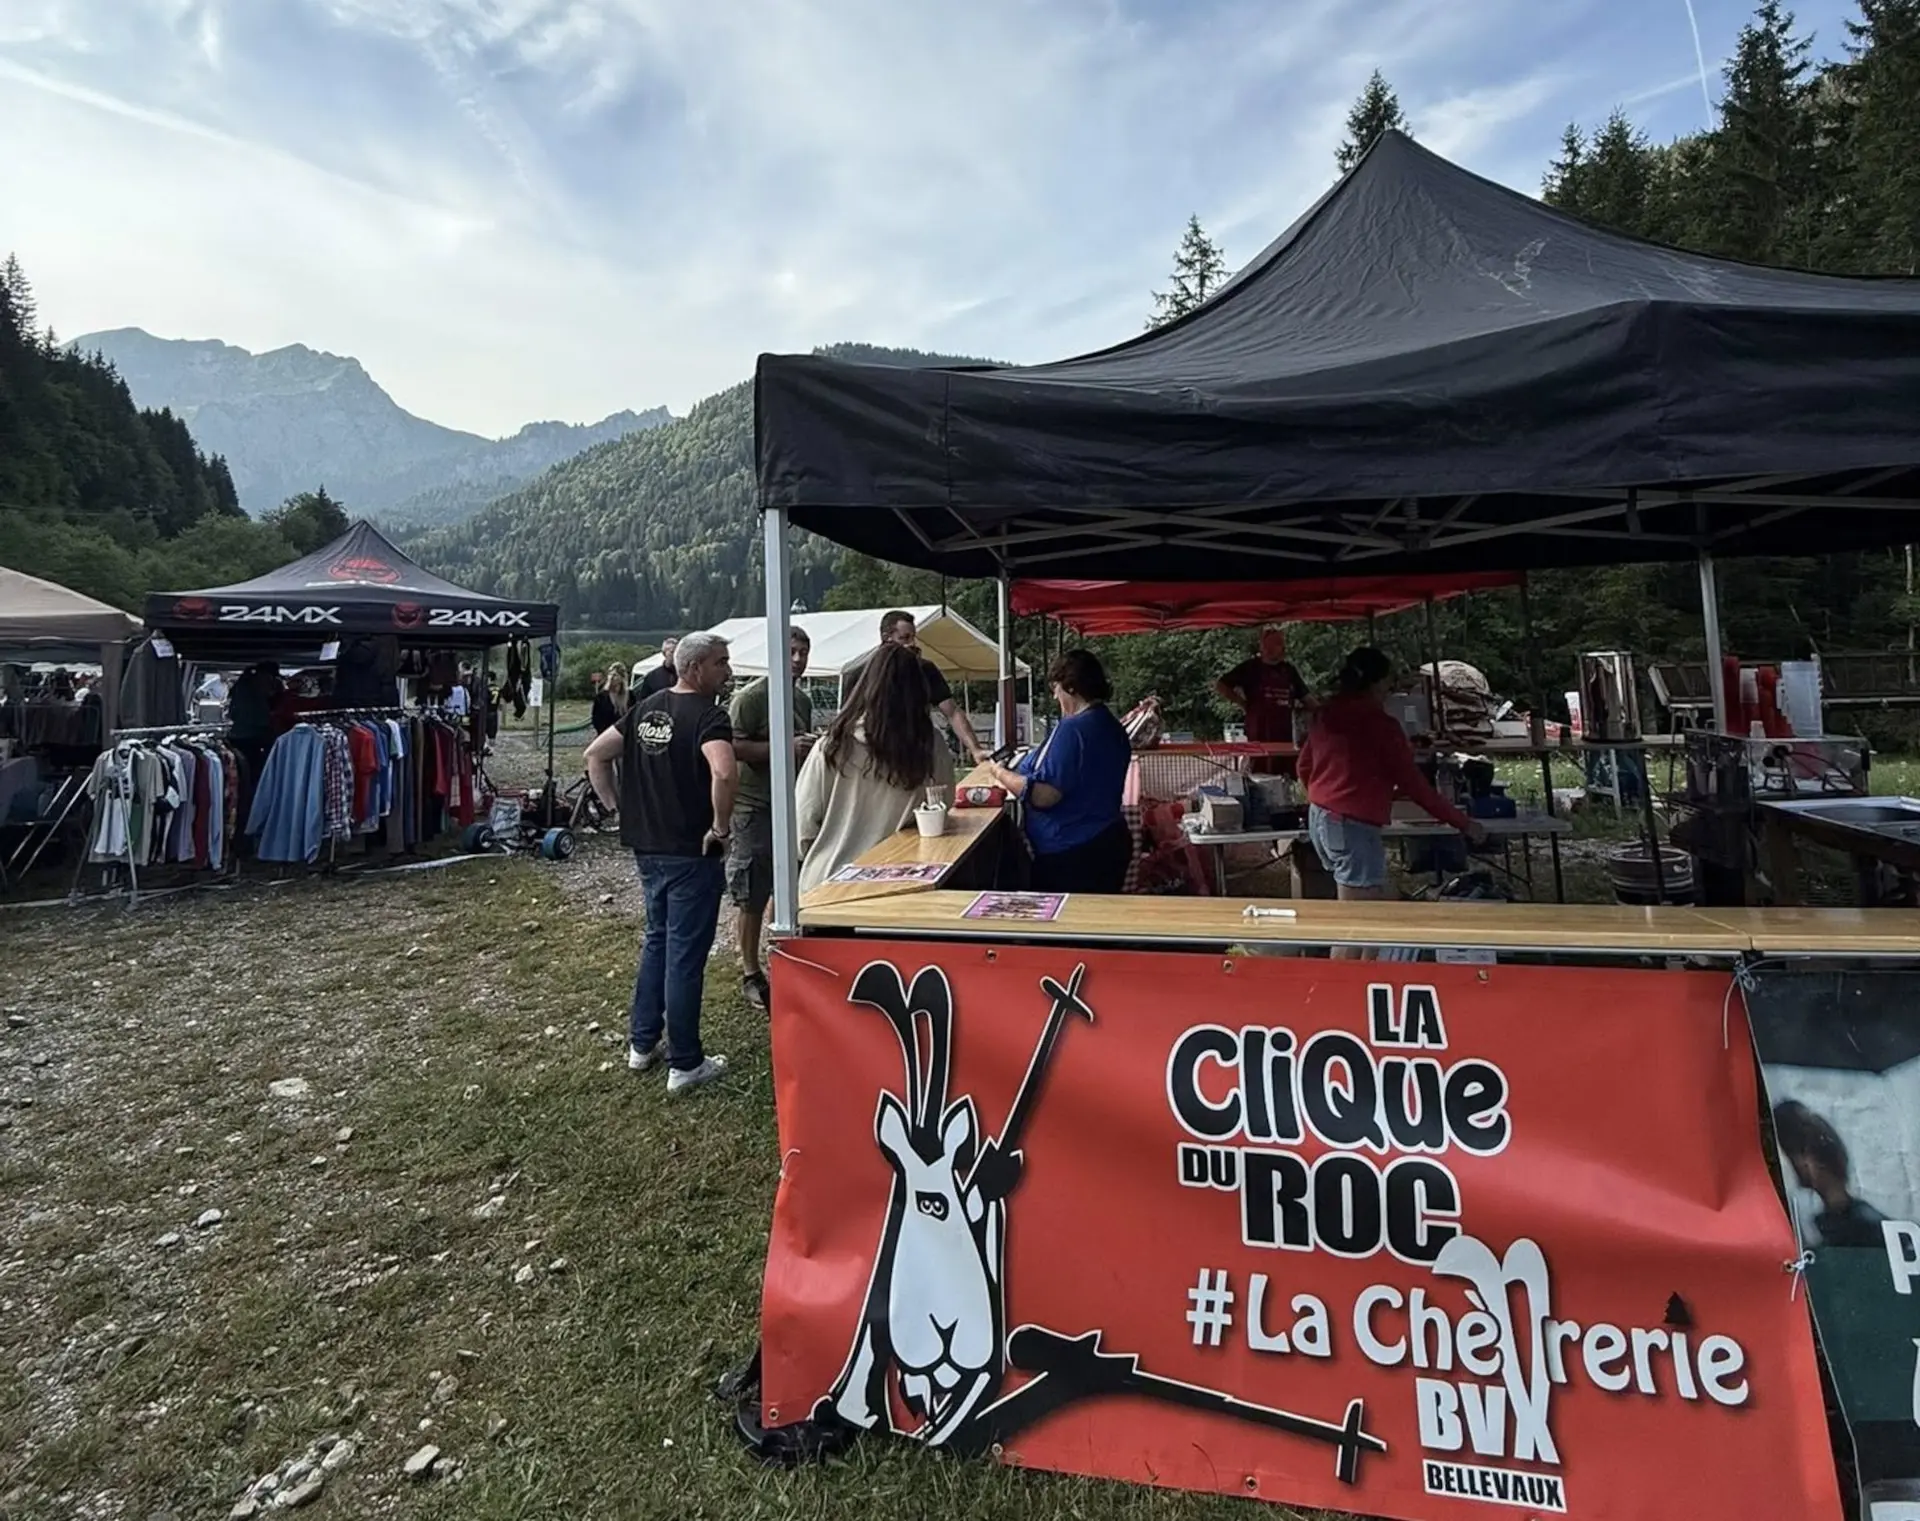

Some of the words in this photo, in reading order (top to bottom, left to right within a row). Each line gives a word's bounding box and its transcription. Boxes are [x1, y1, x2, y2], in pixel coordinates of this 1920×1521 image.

[218, 605, 343, 624] 24MX
[428, 608, 531, 628] 24MX
[1368, 984, 1448, 1049] LA
[1178, 1142, 1240, 1191] DU
[1241, 1147, 1462, 1266] ROC
[1415, 1377, 1560, 1464] BVX
[1425, 1462, 1564, 1509] BELLEVAUX
